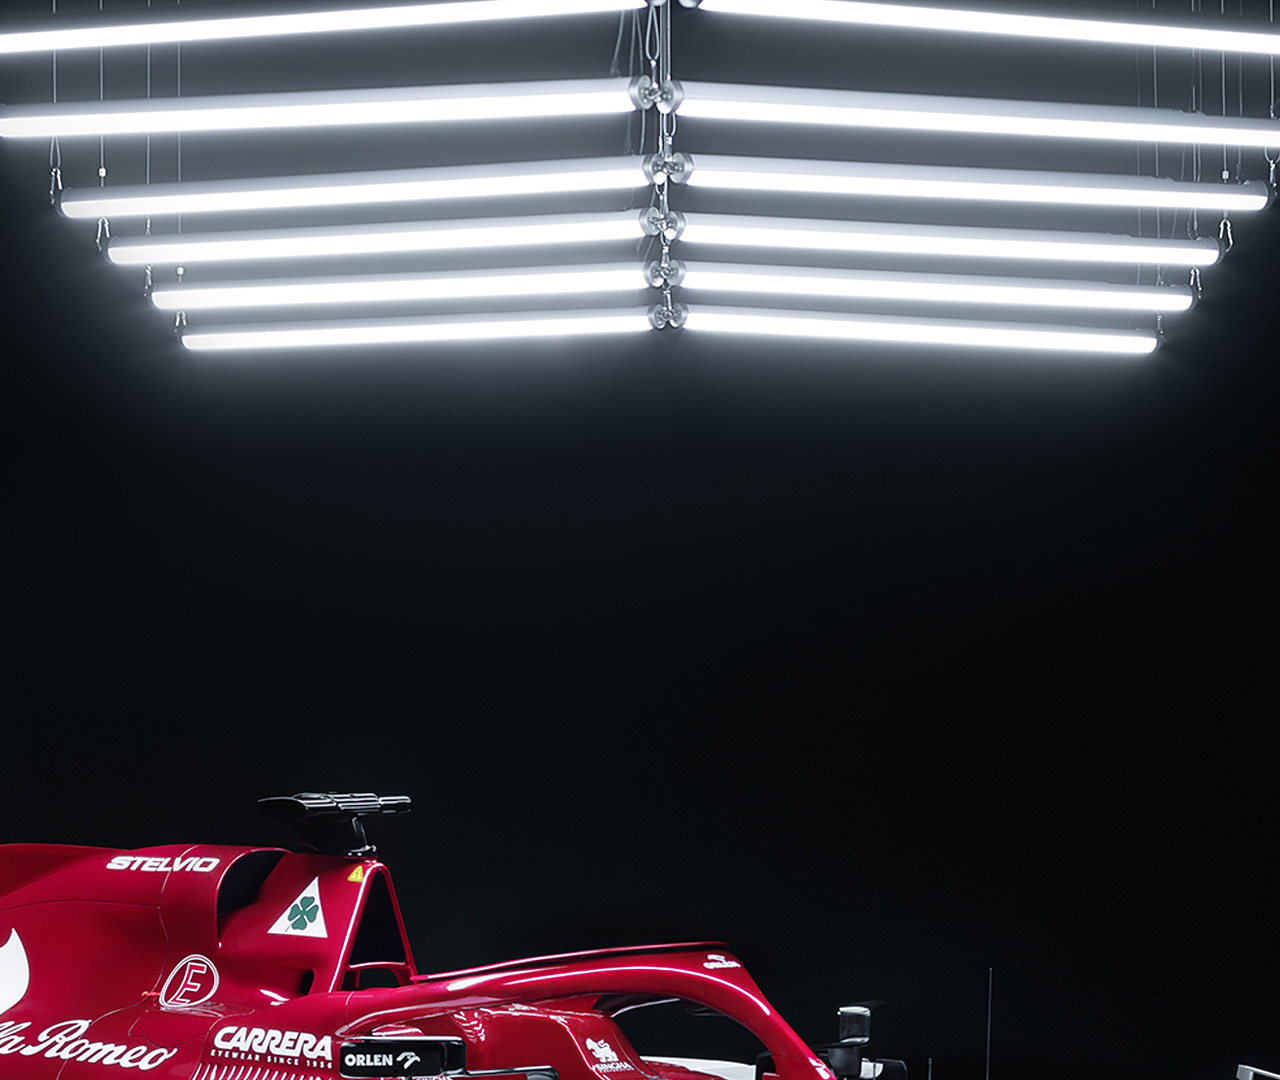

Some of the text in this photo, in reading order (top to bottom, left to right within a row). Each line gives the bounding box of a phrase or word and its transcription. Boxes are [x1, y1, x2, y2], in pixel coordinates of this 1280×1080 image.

[106, 856, 220, 872] STELVIO
[20, 1019, 177, 1071] Romeo
[213, 1025, 333, 1061] CARRERA
[210, 1049, 260, 1061] EYEWEAR
[267, 1055, 299, 1066] SINCE
[344, 1053, 394, 1067] ORLEN
